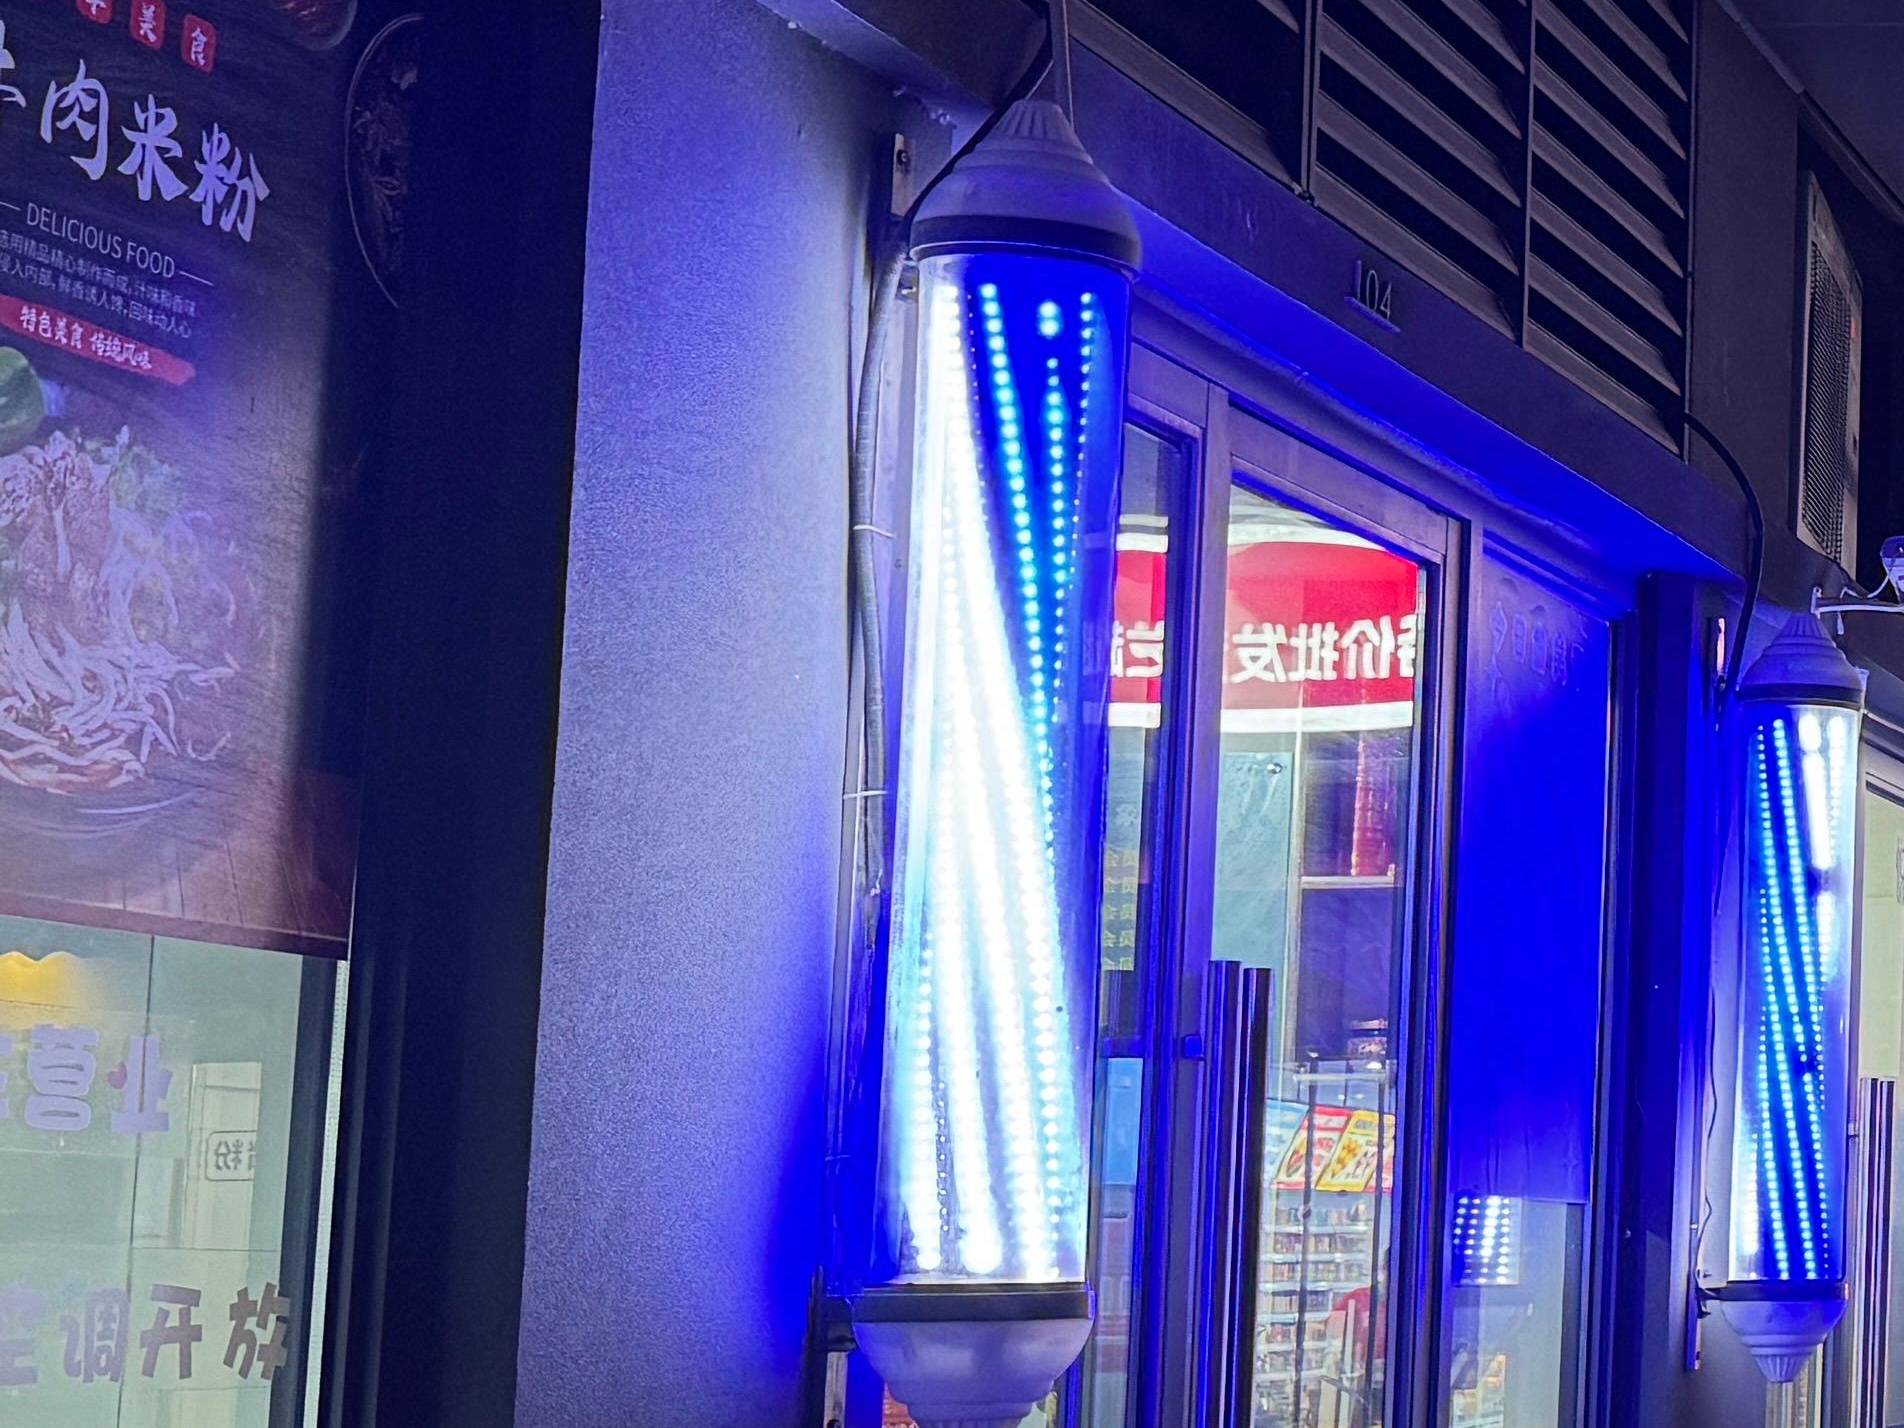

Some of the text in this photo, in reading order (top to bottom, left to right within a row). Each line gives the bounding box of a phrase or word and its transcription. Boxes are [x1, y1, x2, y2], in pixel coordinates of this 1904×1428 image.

[27, 202, 175, 278] DELICIOUS FOOD
[1353, 261, 1392, 320] 104
[20, 305, 84, 349] 特色美食
[0, 1023, 173, 1134] 营业
